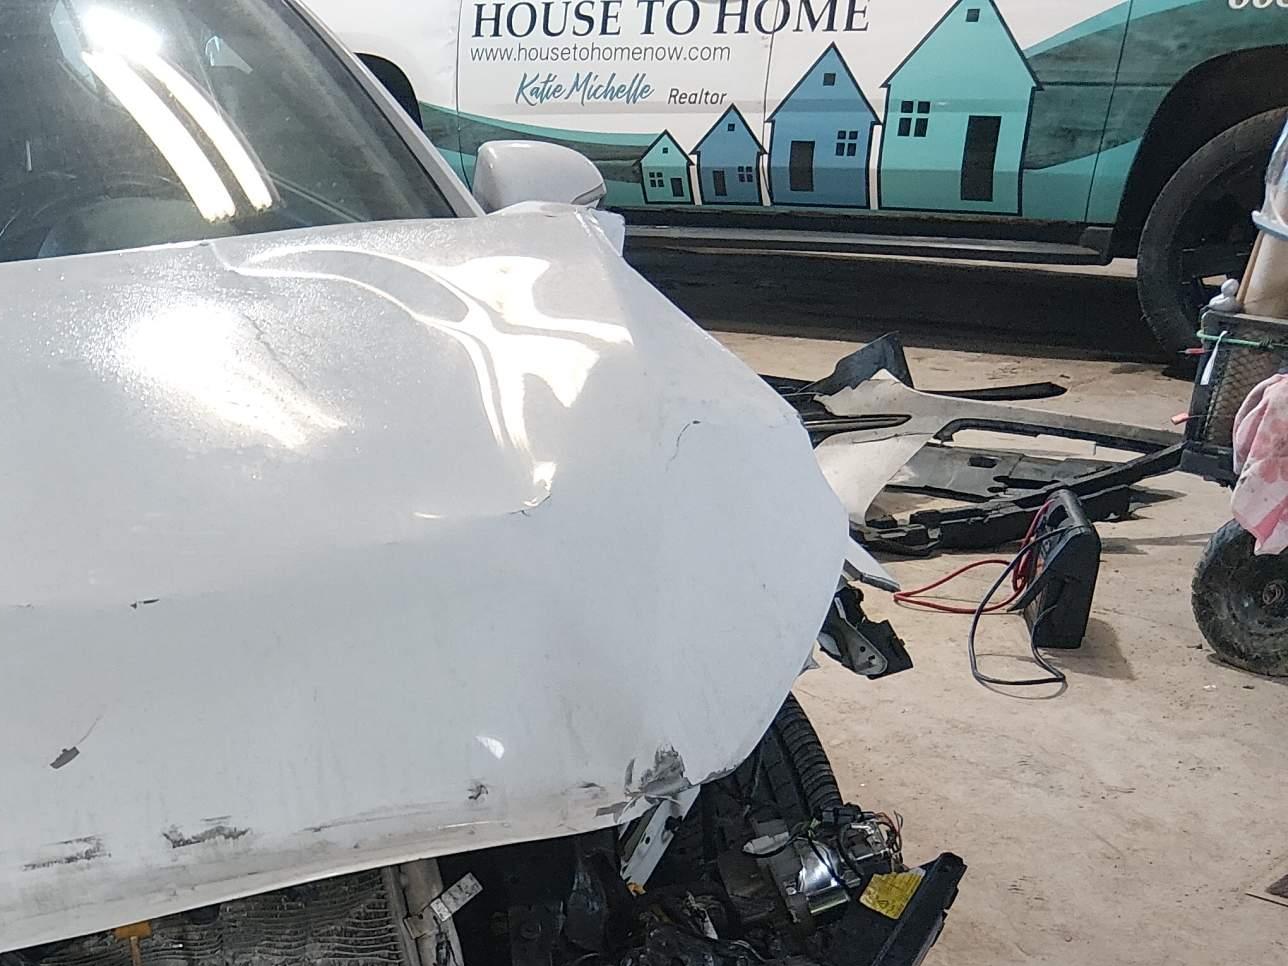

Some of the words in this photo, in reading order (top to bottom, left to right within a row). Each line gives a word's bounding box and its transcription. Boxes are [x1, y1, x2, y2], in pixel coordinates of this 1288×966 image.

[471, 0, 623, 38] HOUSE
[636, 0, 701, 36] TO
[713, 0, 870, 35] HOME
[470, 42, 731, 62] www.housetohomenow.com
[515, 72, 567, 106] Katie
[565, 71, 655, 106] Michelle
[667, 88, 727, 105] Realtor
